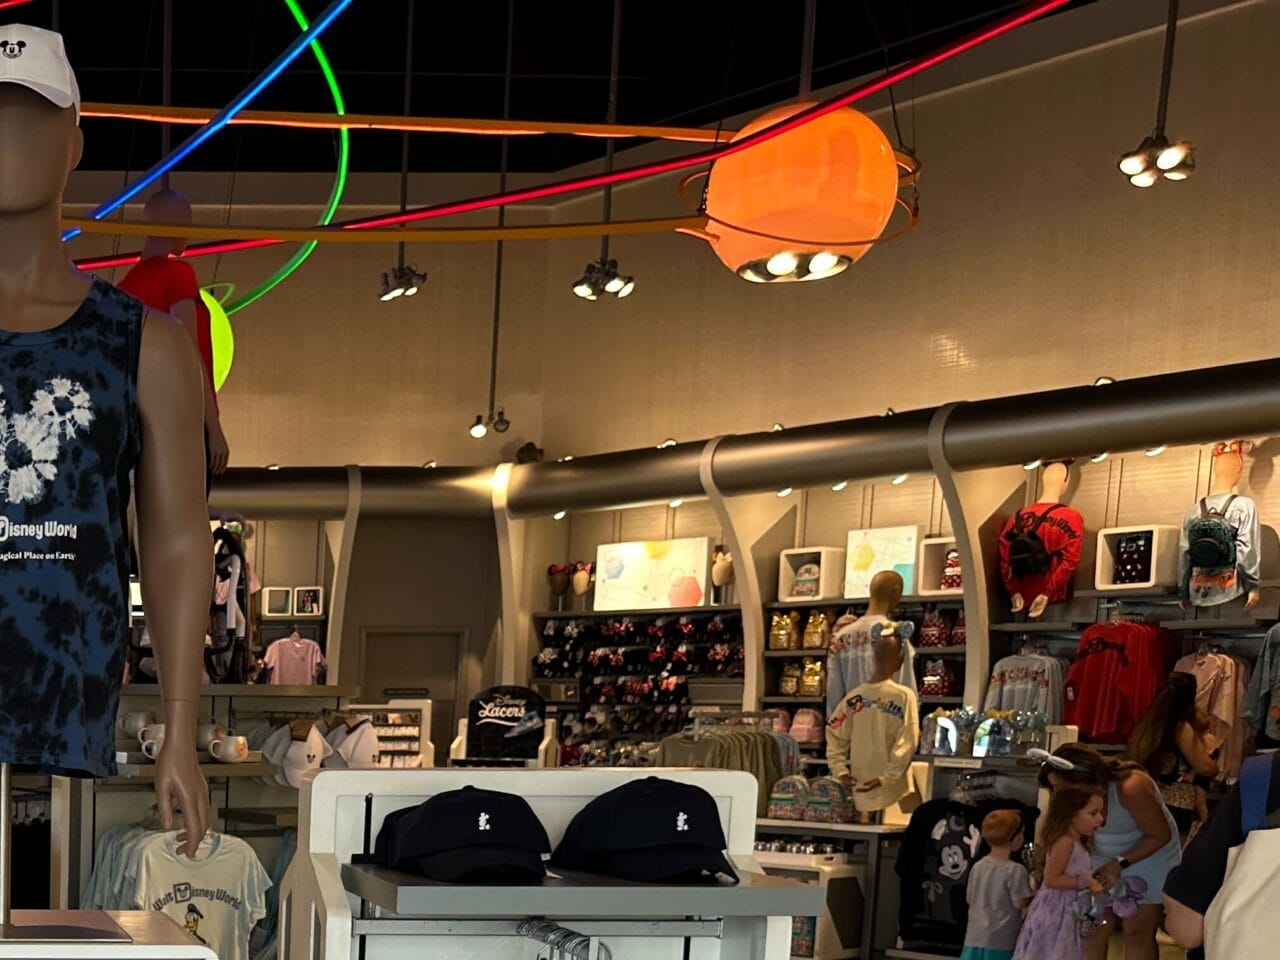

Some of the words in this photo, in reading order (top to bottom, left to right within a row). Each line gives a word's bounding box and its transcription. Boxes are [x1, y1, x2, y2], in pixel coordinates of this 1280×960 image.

[45, 521, 77, 539] World
[24, 551, 44, 560] Place
[478, 700, 526, 718] Lacers
[153, 892, 175, 911] Walt
